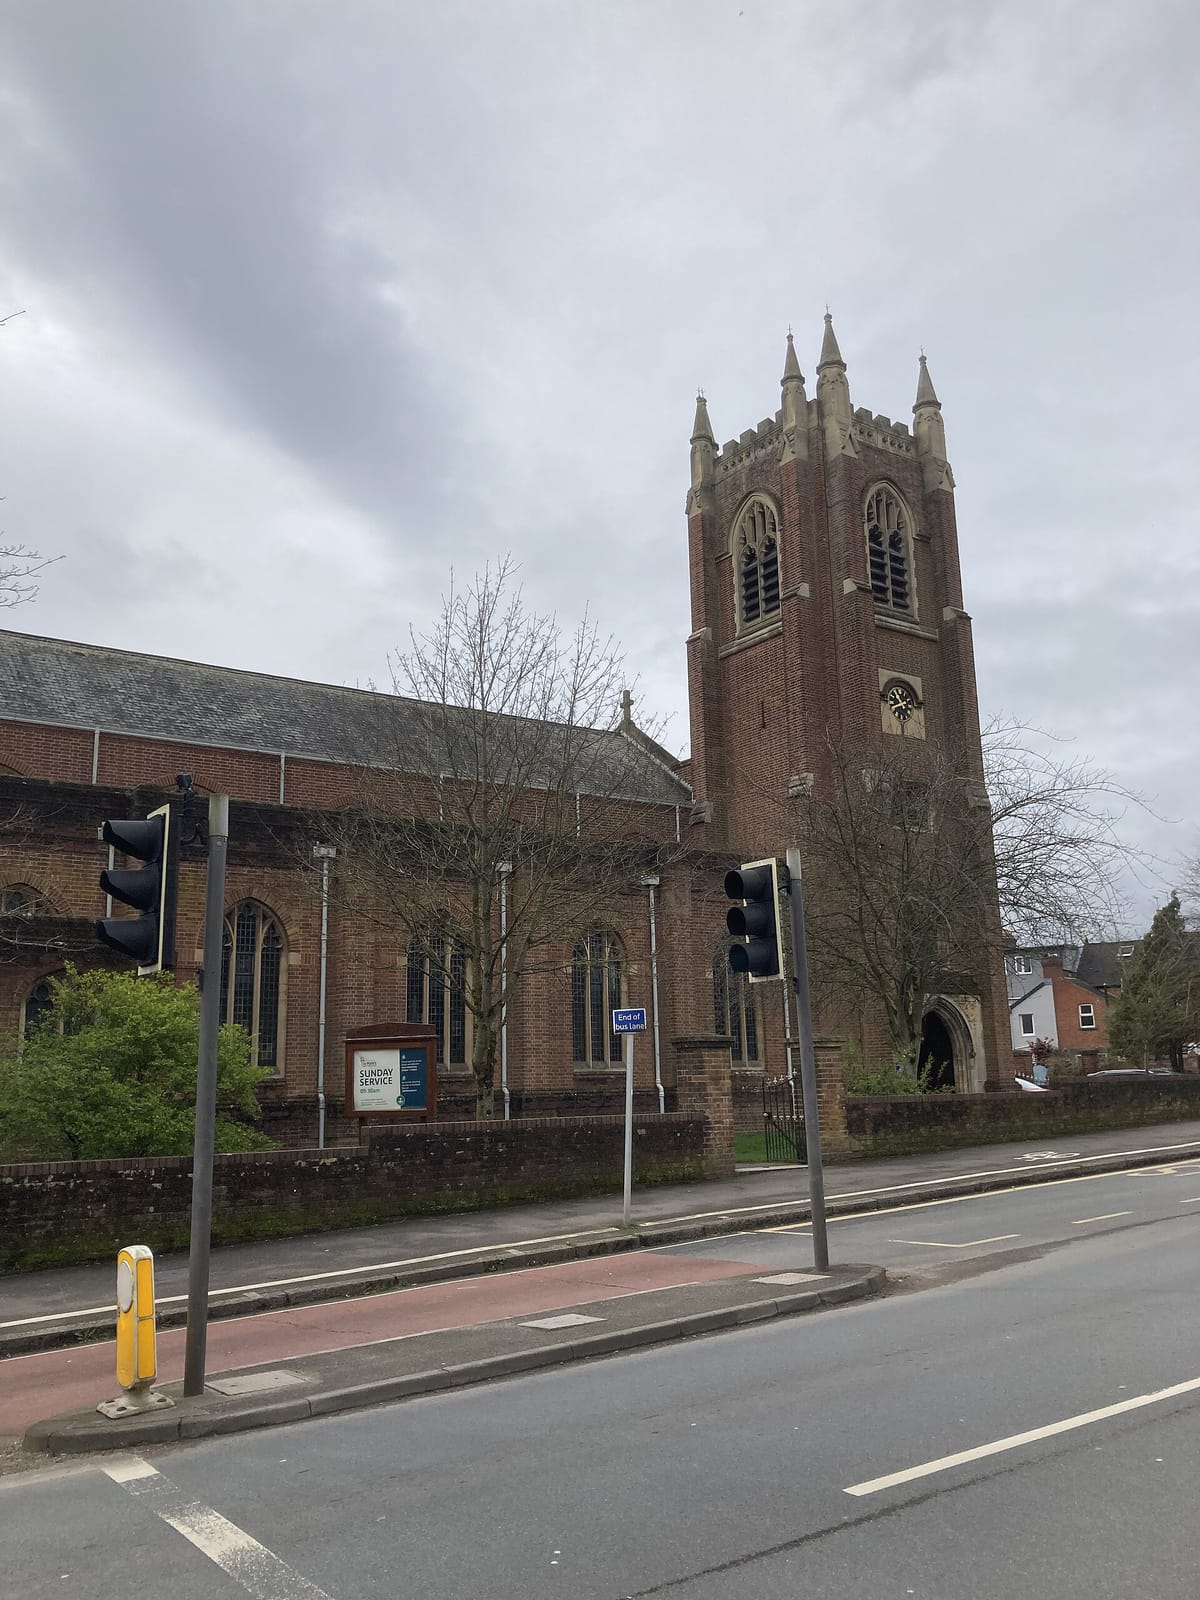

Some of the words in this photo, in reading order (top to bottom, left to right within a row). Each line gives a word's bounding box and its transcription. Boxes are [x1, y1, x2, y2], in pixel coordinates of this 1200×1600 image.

[618, 1013, 631, 1021] End
[360, 1068, 393, 1077] SUNDAY
[360, 1077, 392, 1086] SERVICE
